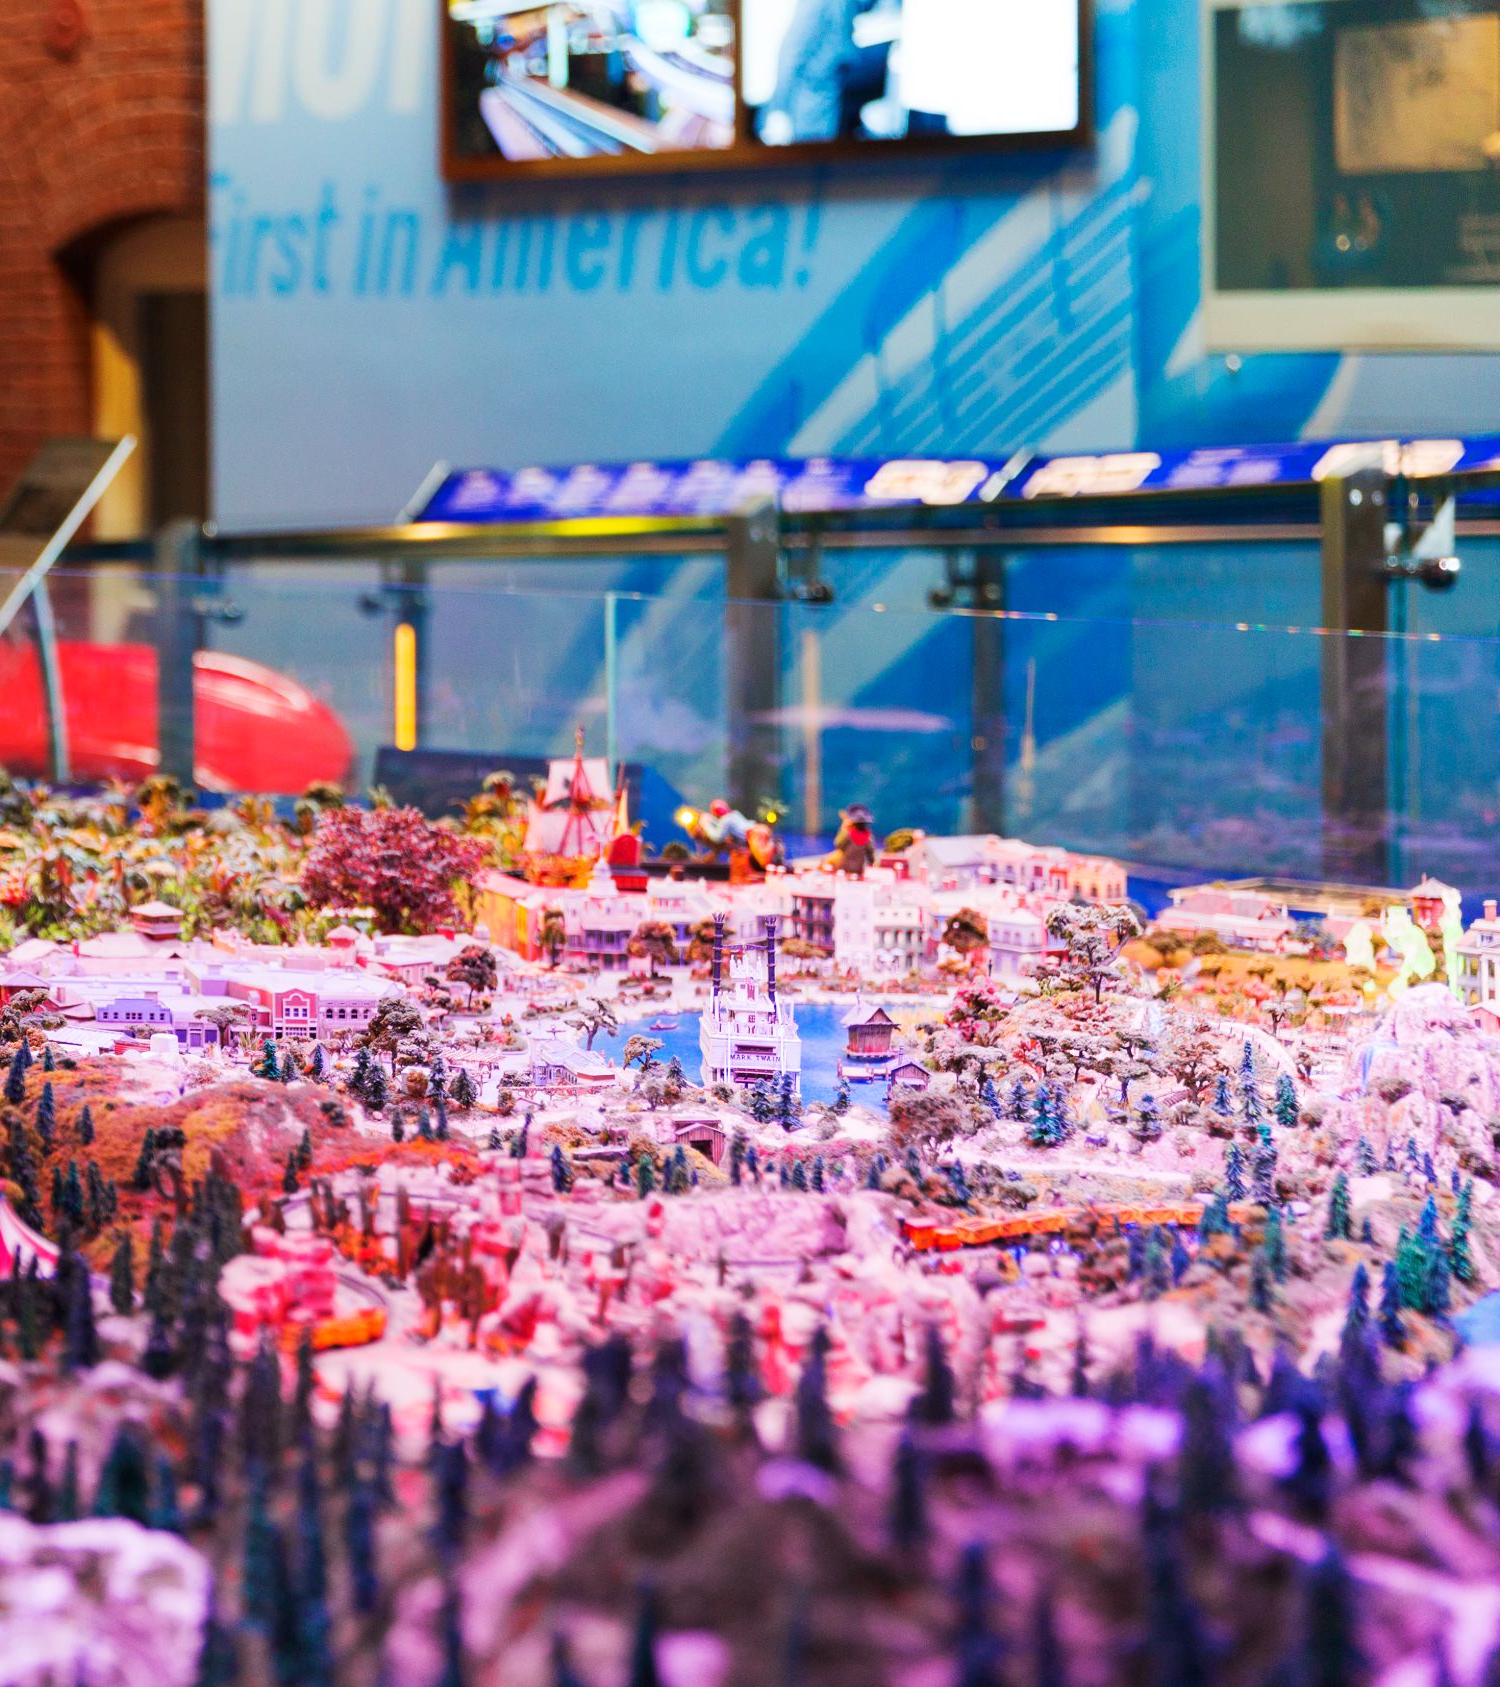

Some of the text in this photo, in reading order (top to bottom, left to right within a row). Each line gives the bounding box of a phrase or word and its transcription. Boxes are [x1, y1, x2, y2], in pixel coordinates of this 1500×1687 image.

[352, 184, 420, 297] in
[429, 182, 824, 297] America!
[730, 1053, 781, 1062] MARK TWAIN
